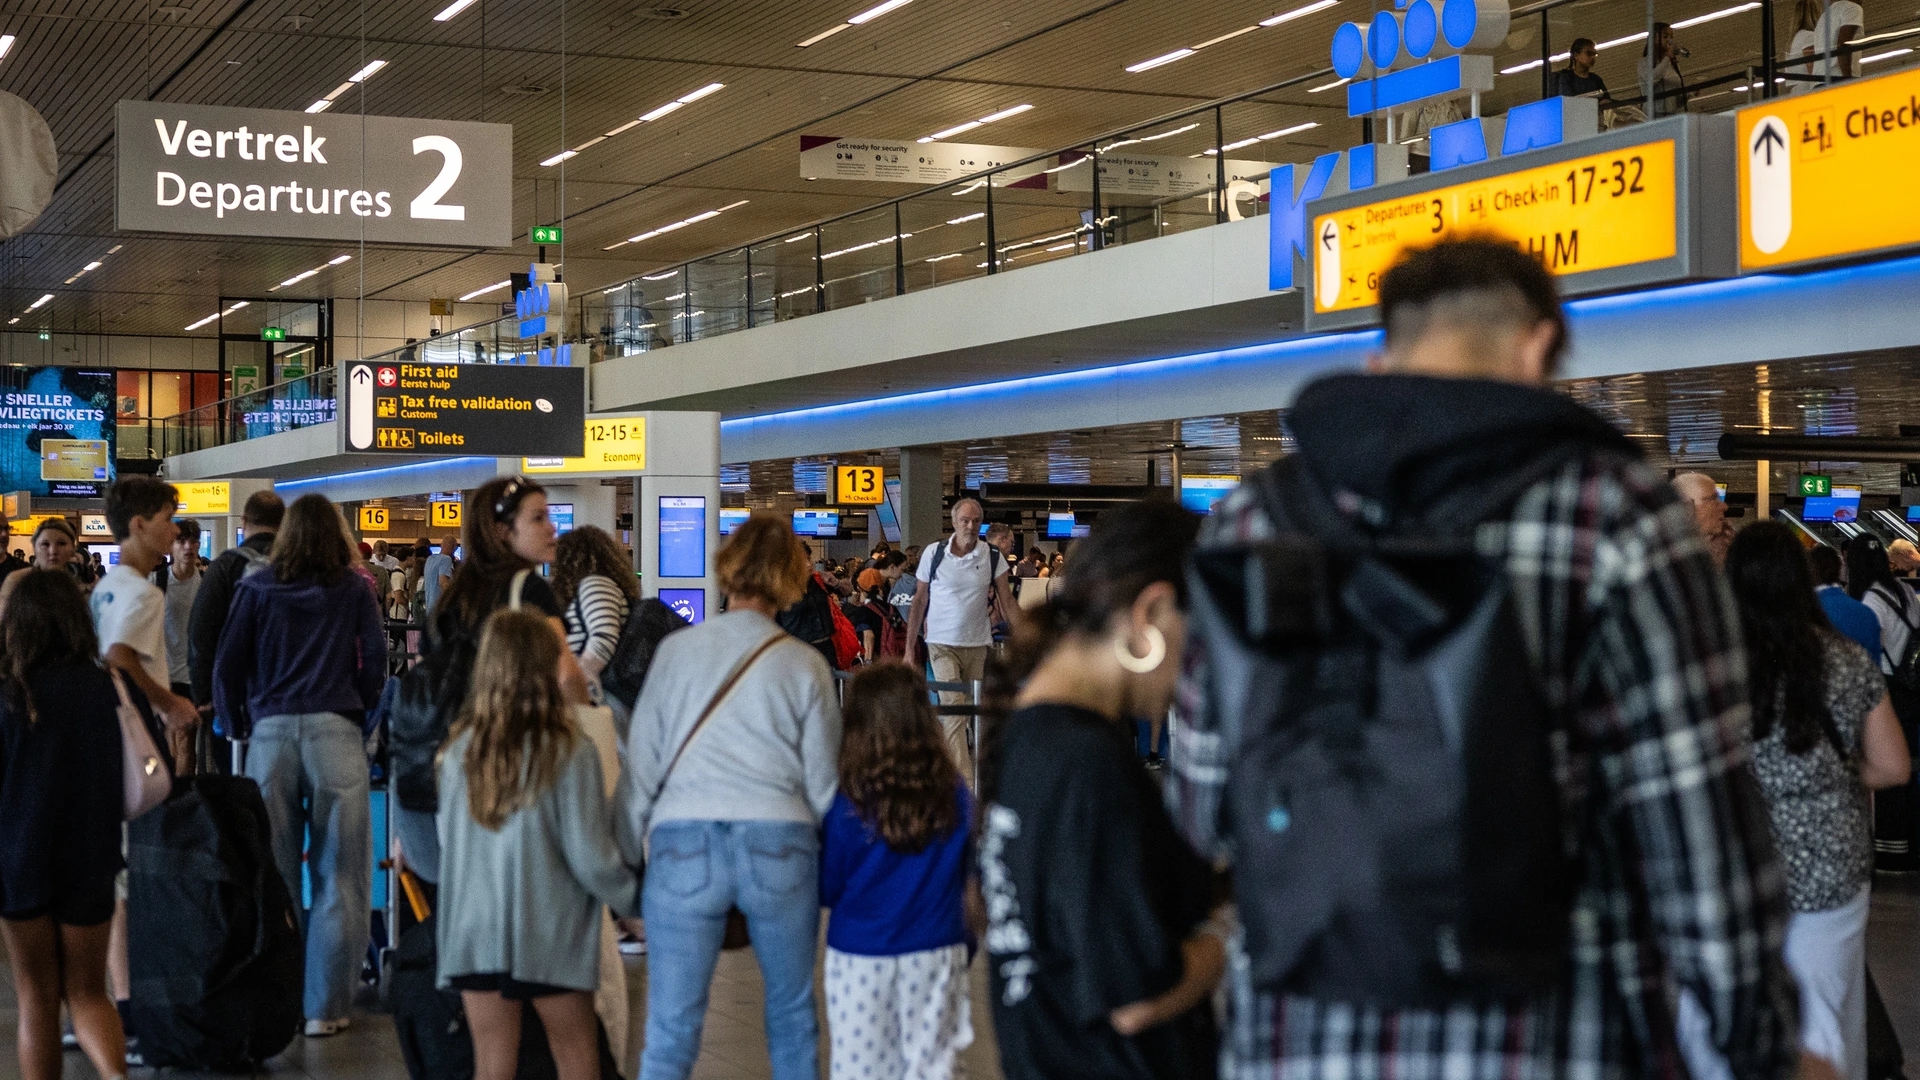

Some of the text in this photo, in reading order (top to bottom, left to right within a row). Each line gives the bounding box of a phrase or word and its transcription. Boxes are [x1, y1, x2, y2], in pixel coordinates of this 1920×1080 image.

[154, 118, 328, 164] Vertrek
[836, 142, 908, 153] Get ready for security
[410, 135, 465, 221] 2
[156, 171, 392, 218] Departures
[1366, 155, 1644, 233] Departures 3 Check-in 17-32
[401, 365, 458, 379] First aid
[401, 379, 450, 390] Eerste hulp
[5, 393, 73, 407] SNELLER
[400, 395, 532, 410] Tax free validation
[401, 409, 438, 419] Customs
[39, 423, 52, 431] jaar
[590, 424, 627, 441] 12-15
[418, 432, 464, 445] Toilets
[603, 452, 641, 464] Economy
[846, 469, 875, 493] 13
[211, 485, 220, 495] 16
[365, 510, 384, 524] 16
[438, 504, 458, 520] 15
